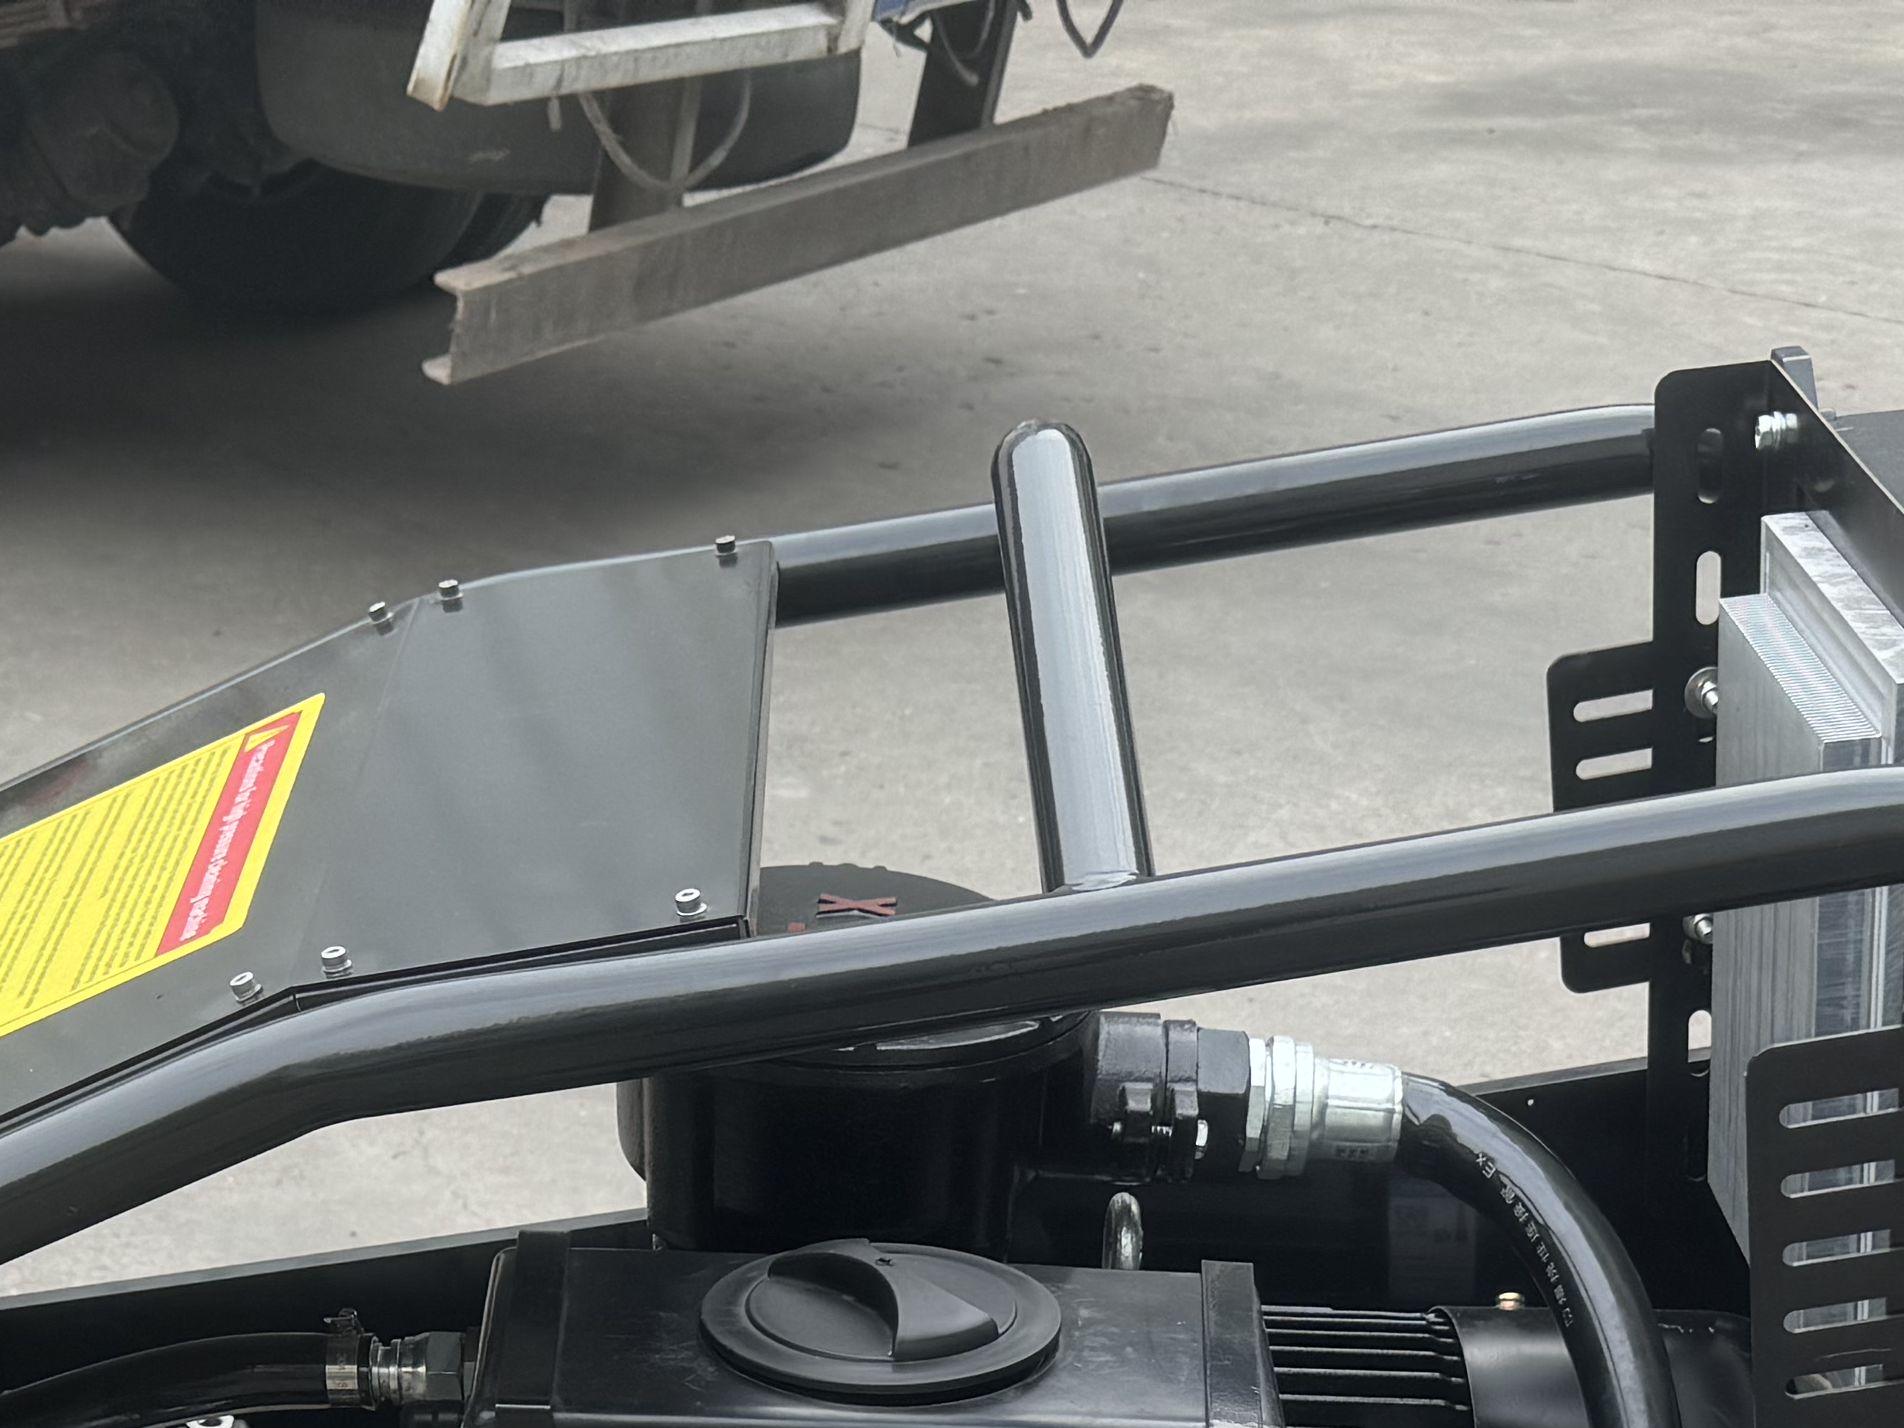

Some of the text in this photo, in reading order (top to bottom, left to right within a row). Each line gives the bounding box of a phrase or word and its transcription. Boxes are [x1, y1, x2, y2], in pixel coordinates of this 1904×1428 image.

[210, 820, 239, 862] pressure
[190, 857, 228, 904] cleaning
[1476, 1152, 1496, 1179] Ex
